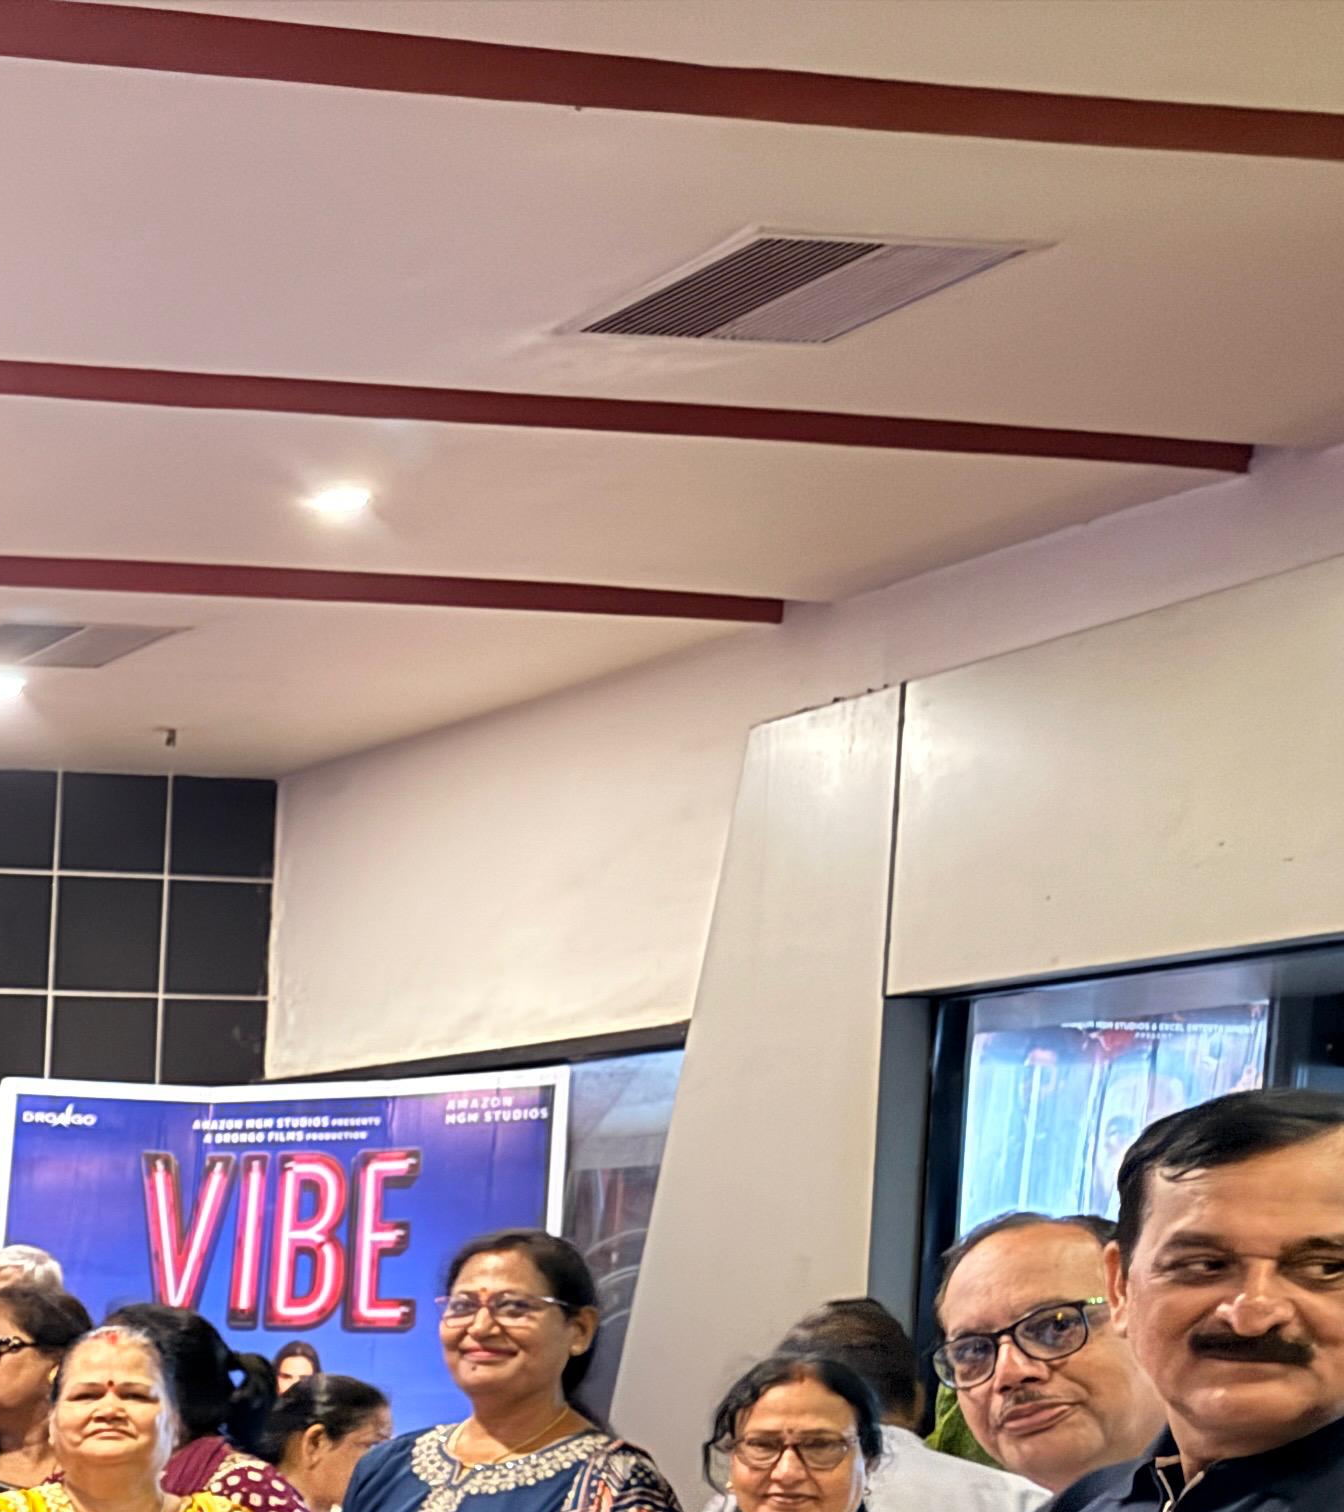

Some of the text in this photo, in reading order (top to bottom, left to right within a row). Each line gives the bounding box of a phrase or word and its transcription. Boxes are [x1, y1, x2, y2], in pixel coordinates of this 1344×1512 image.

[446, 1096, 515, 1110] AMAZON
[192, 1119, 243, 1130] AMAZON
[276, 1116, 330, 1128] STUDIOS
[445, 1107, 548, 1125] MGM STUDIOS
[267, 1131, 304, 1142] FILMS
[141, 1147, 421, 1333] VIBE
